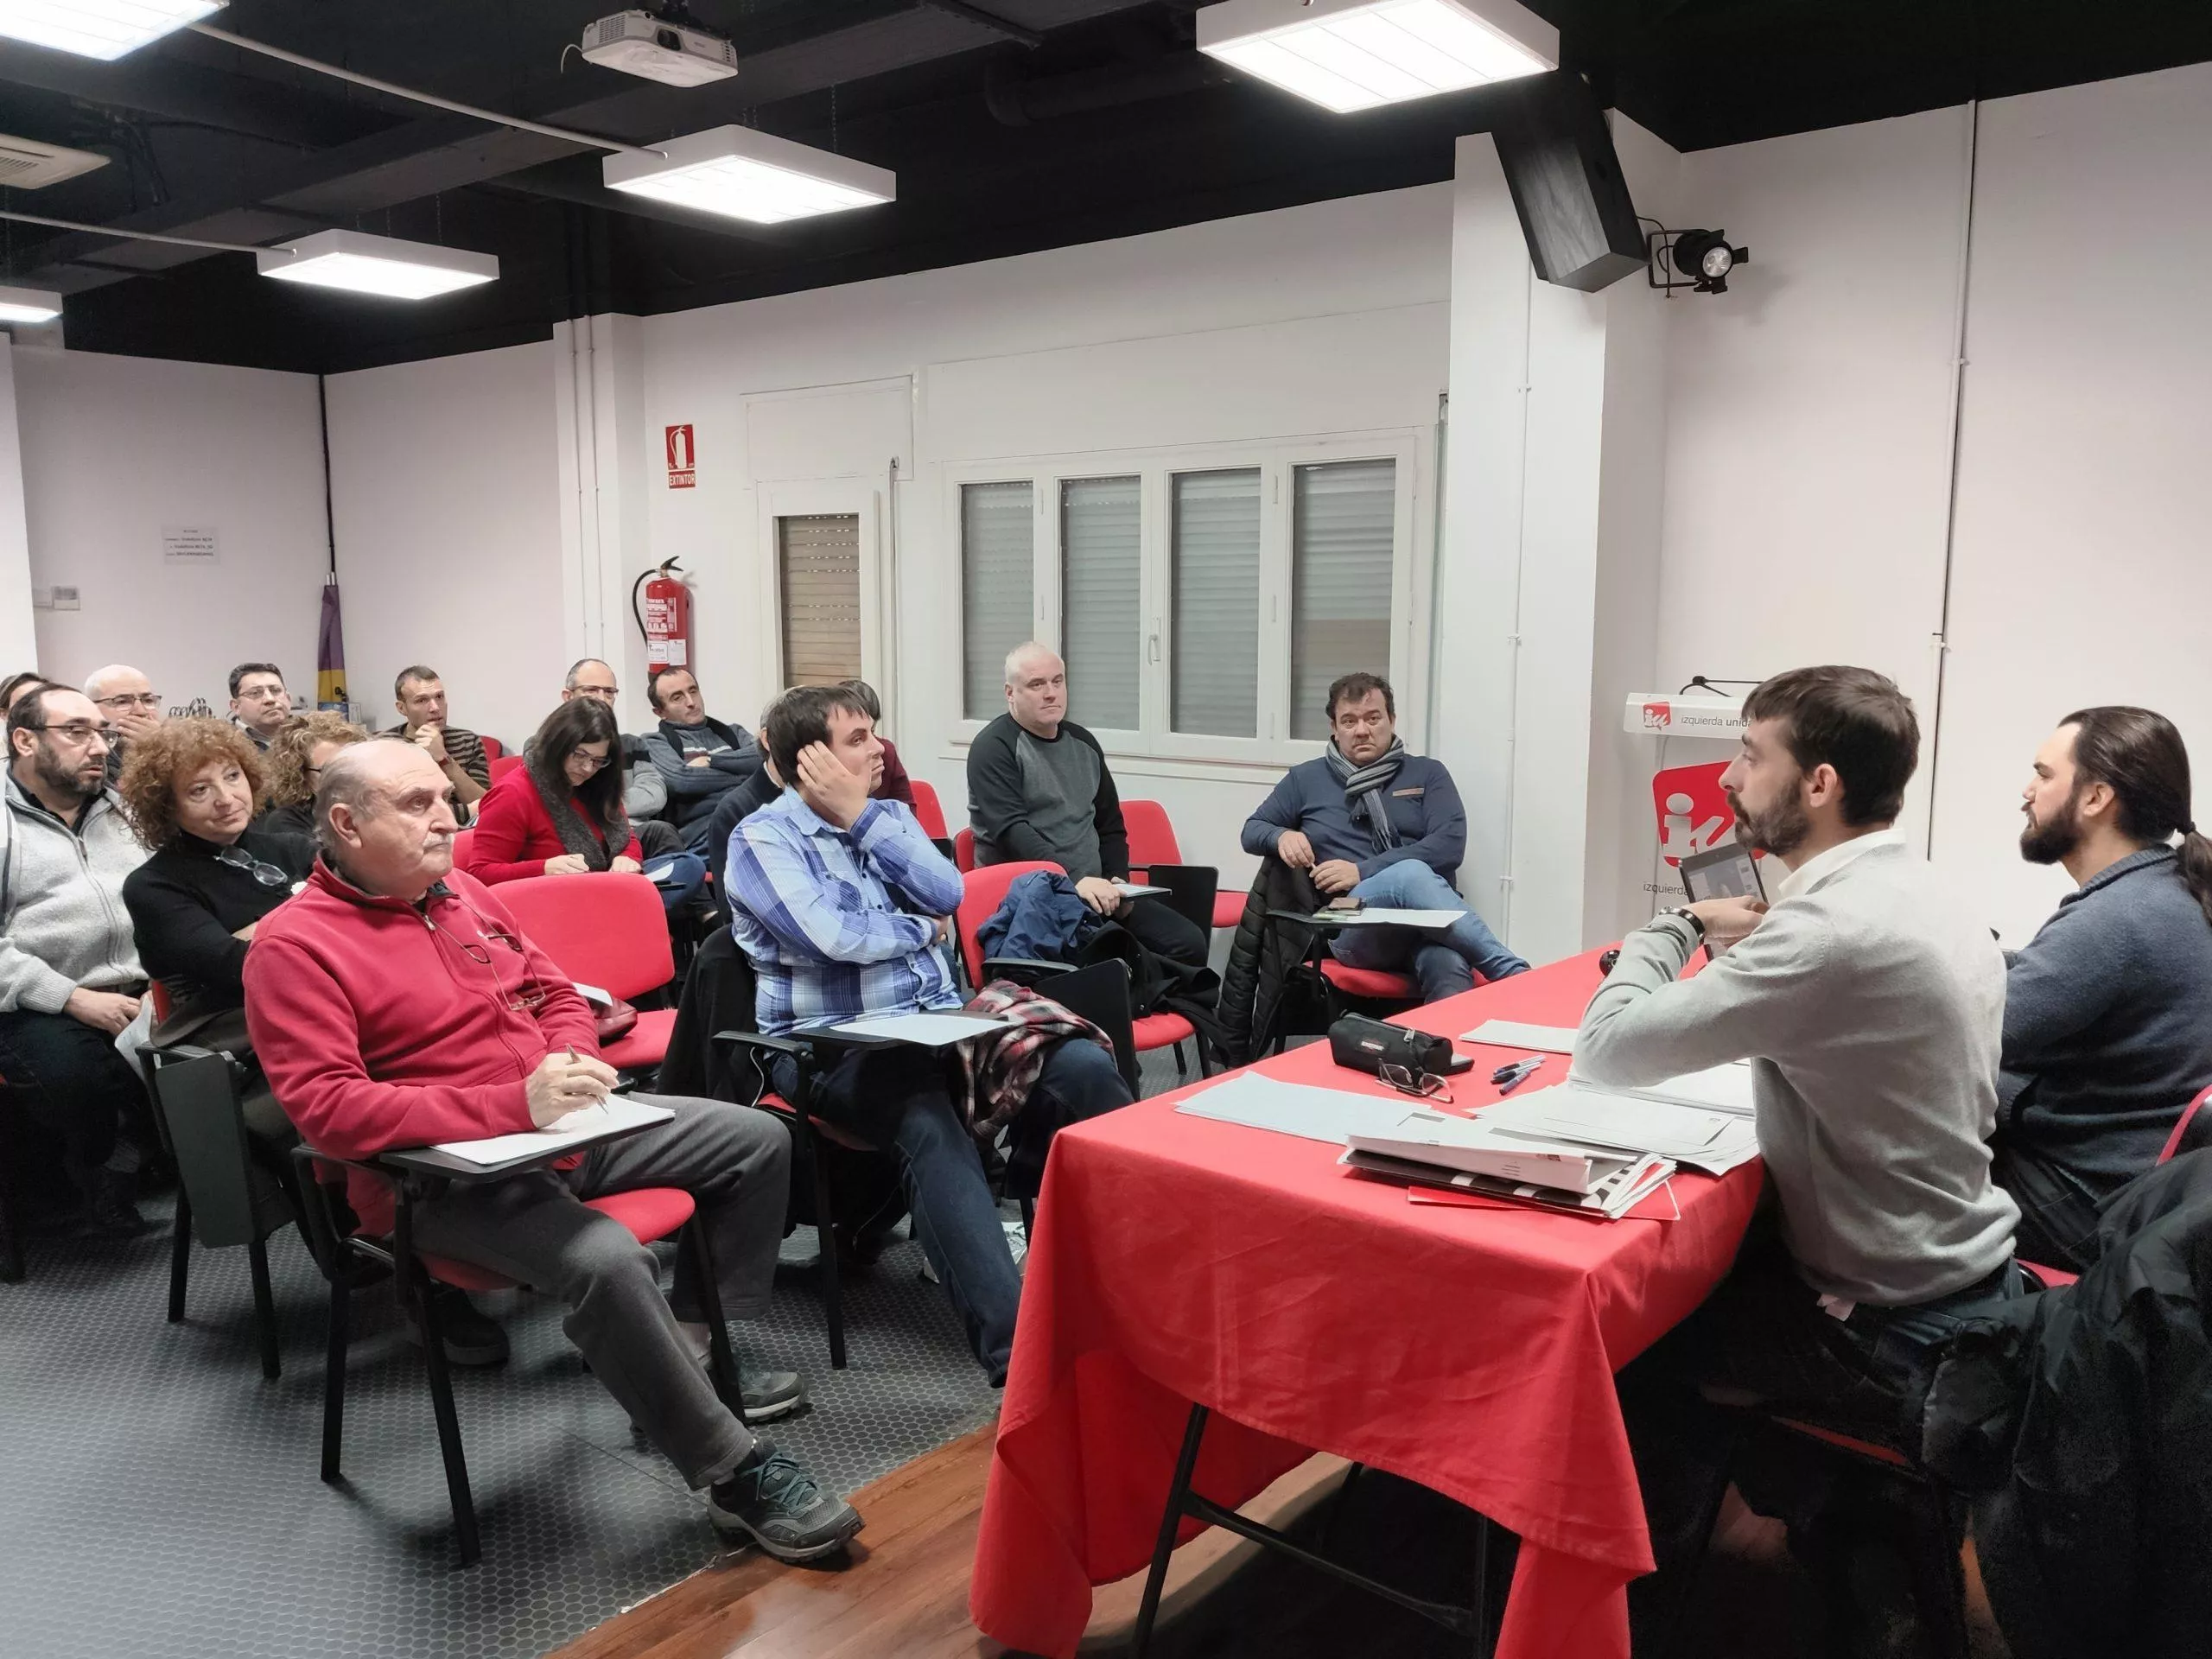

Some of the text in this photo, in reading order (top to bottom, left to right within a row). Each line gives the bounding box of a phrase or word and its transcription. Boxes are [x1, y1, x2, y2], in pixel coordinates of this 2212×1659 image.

[670, 474, 696, 486] EXTINTOR
[1681, 715, 1750, 728] izquierda unid
[1643, 881, 1688, 896] izquierda
